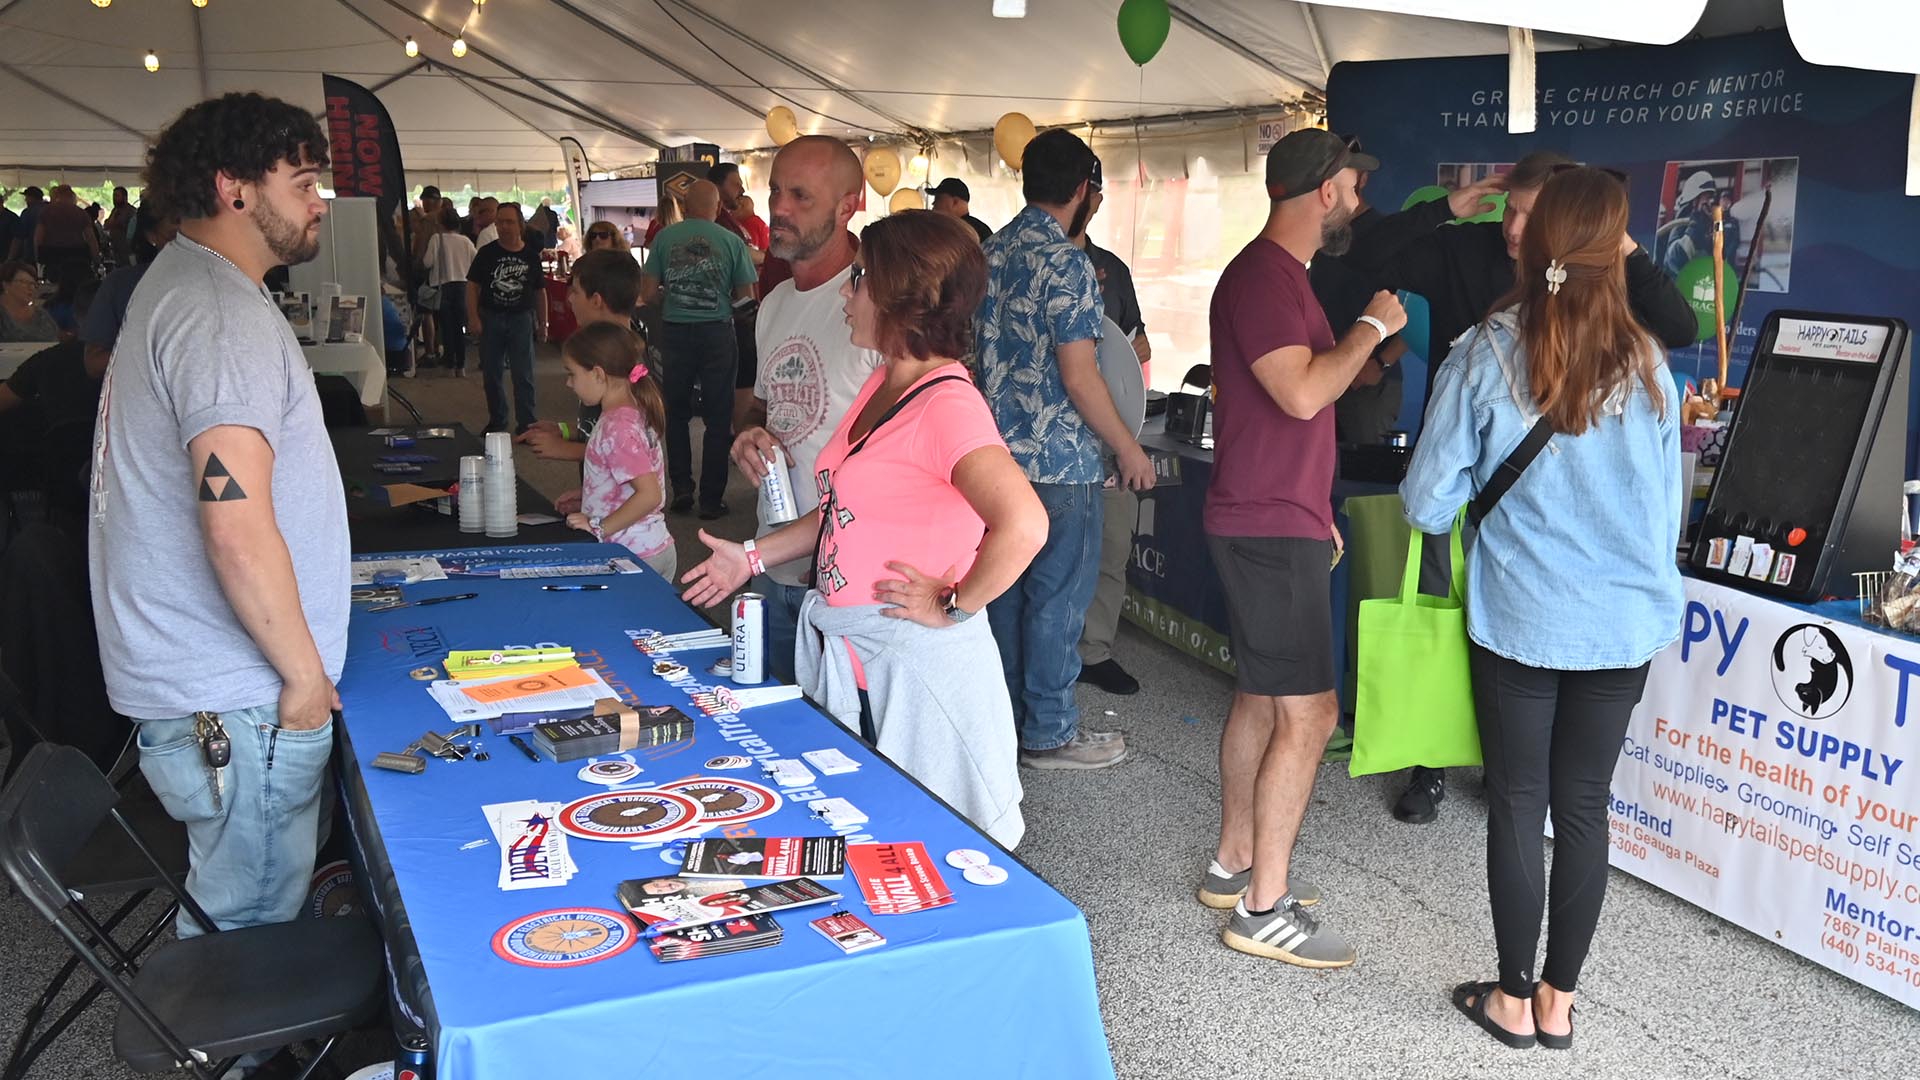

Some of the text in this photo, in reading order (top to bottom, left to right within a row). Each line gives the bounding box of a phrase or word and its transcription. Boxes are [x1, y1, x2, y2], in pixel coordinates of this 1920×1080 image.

[1472, 69, 1786, 106] GRE CHURCH OF MENTOR
[1440, 92, 1805, 128] THAN YOU FOR YOUR SERVICE
[355, 113, 384, 198] NOW
[1691, 301, 1717, 313] RAC
[1797, 324, 1868, 345] HAPPY TAILS
[1131, 543, 1166, 578] ACE
[735, 623, 746, 673] ULTRA
[1711, 698, 1904, 786] PET SUPPLY
[1654, 717, 1920, 833] For the health of your
[1622, 736, 1650, 765] Cat
[1737, 782, 1834, 840] Grooming
[1847, 823, 1891, 858] Self
[876, 844, 898, 866] ALL
[1633, 826, 1681, 860] Geauga
[1684, 851, 1720, 879] Plaza
[1652, 781, 1920, 905] www.happytailspetsupply.c
[550, 859, 562, 879] LOCAL
[884, 874, 922, 910] WALL
[517, 914, 573, 934] ELECTRICAL
[576, 914, 619, 929] WORKERS
[1823, 912, 1861, 940] 7867
[509, 938, 563, 962] BROTHERHOOD
[1821, 931, 1860, 965] (440)
